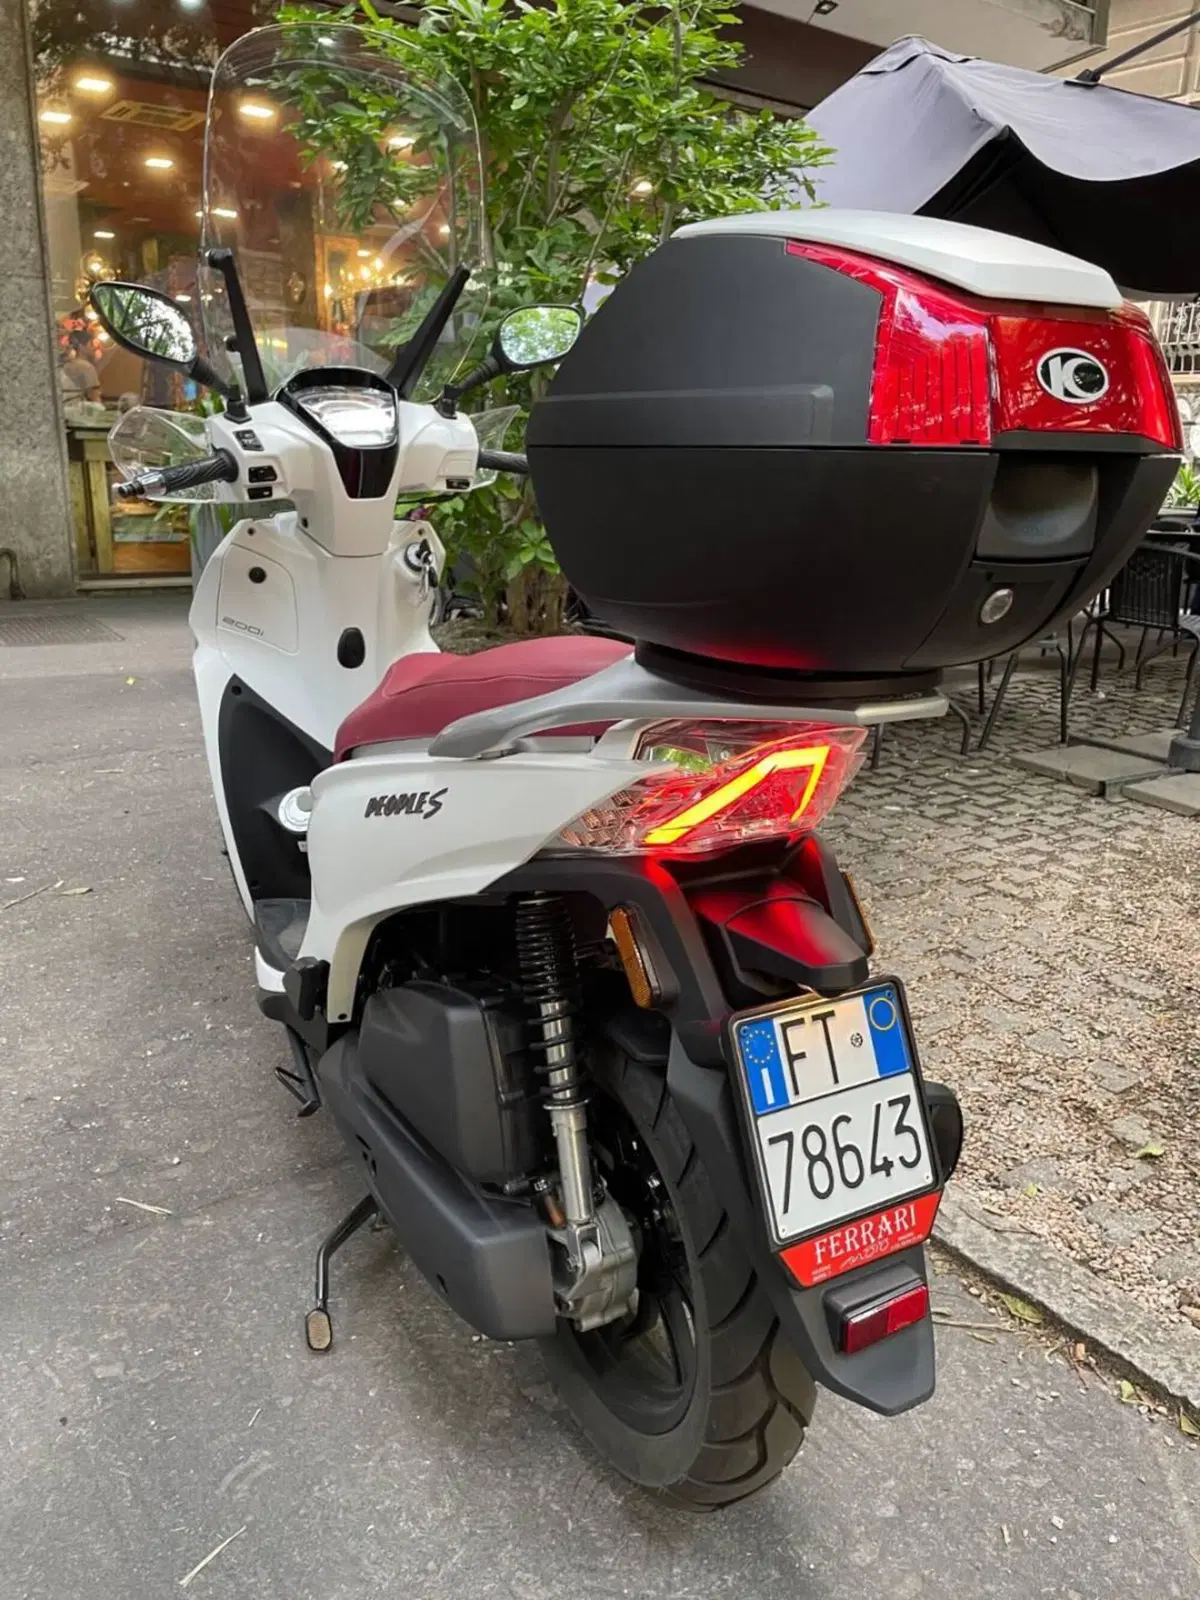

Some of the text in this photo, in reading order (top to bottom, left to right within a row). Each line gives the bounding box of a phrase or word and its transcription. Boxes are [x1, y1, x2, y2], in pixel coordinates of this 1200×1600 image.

[780, 1009, 840, 1096] FT
[768, 1094, 922, 1215] 78643
[814, 1204, 917, 1265] FERRARI
